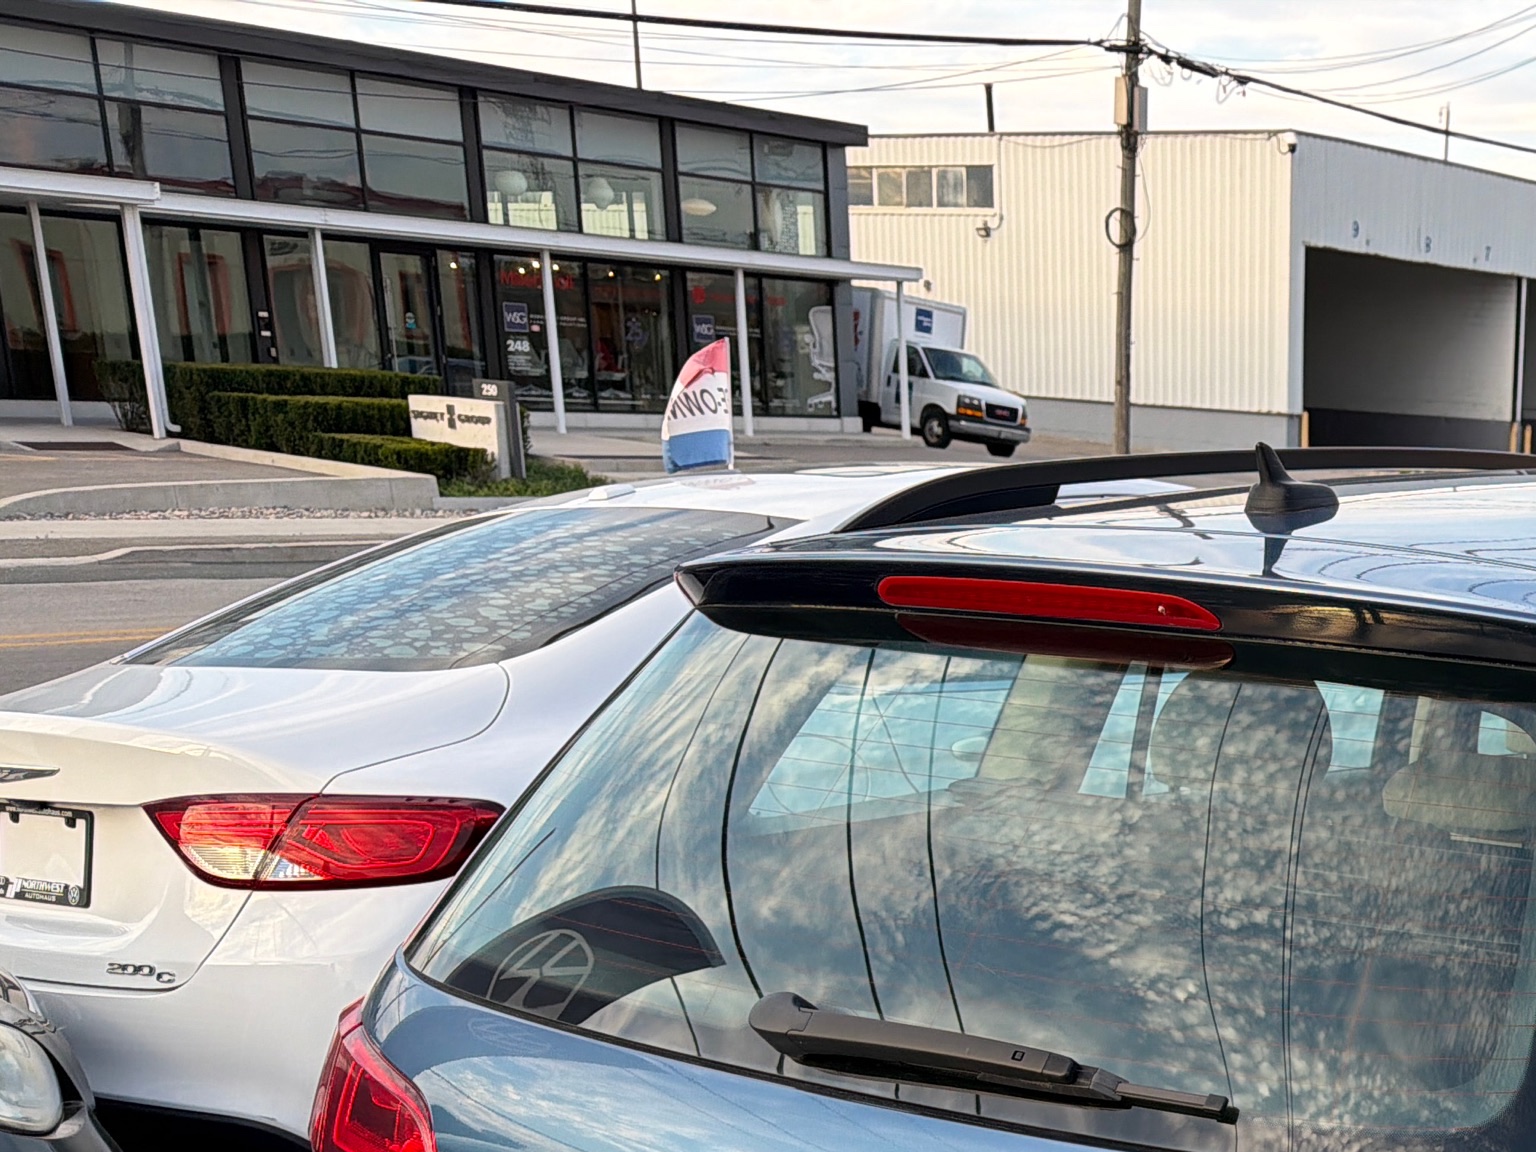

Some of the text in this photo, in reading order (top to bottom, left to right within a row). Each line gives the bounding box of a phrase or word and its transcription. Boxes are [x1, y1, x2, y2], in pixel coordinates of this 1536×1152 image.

[506, 340, 530, 352] 248
[481, 383, 498, 397] 250
[21, 880, 66, 893] NORTHWEST
[24, 892, 57, 902] AUTOHAUS
[106, 962, 176, 983] 200 C
